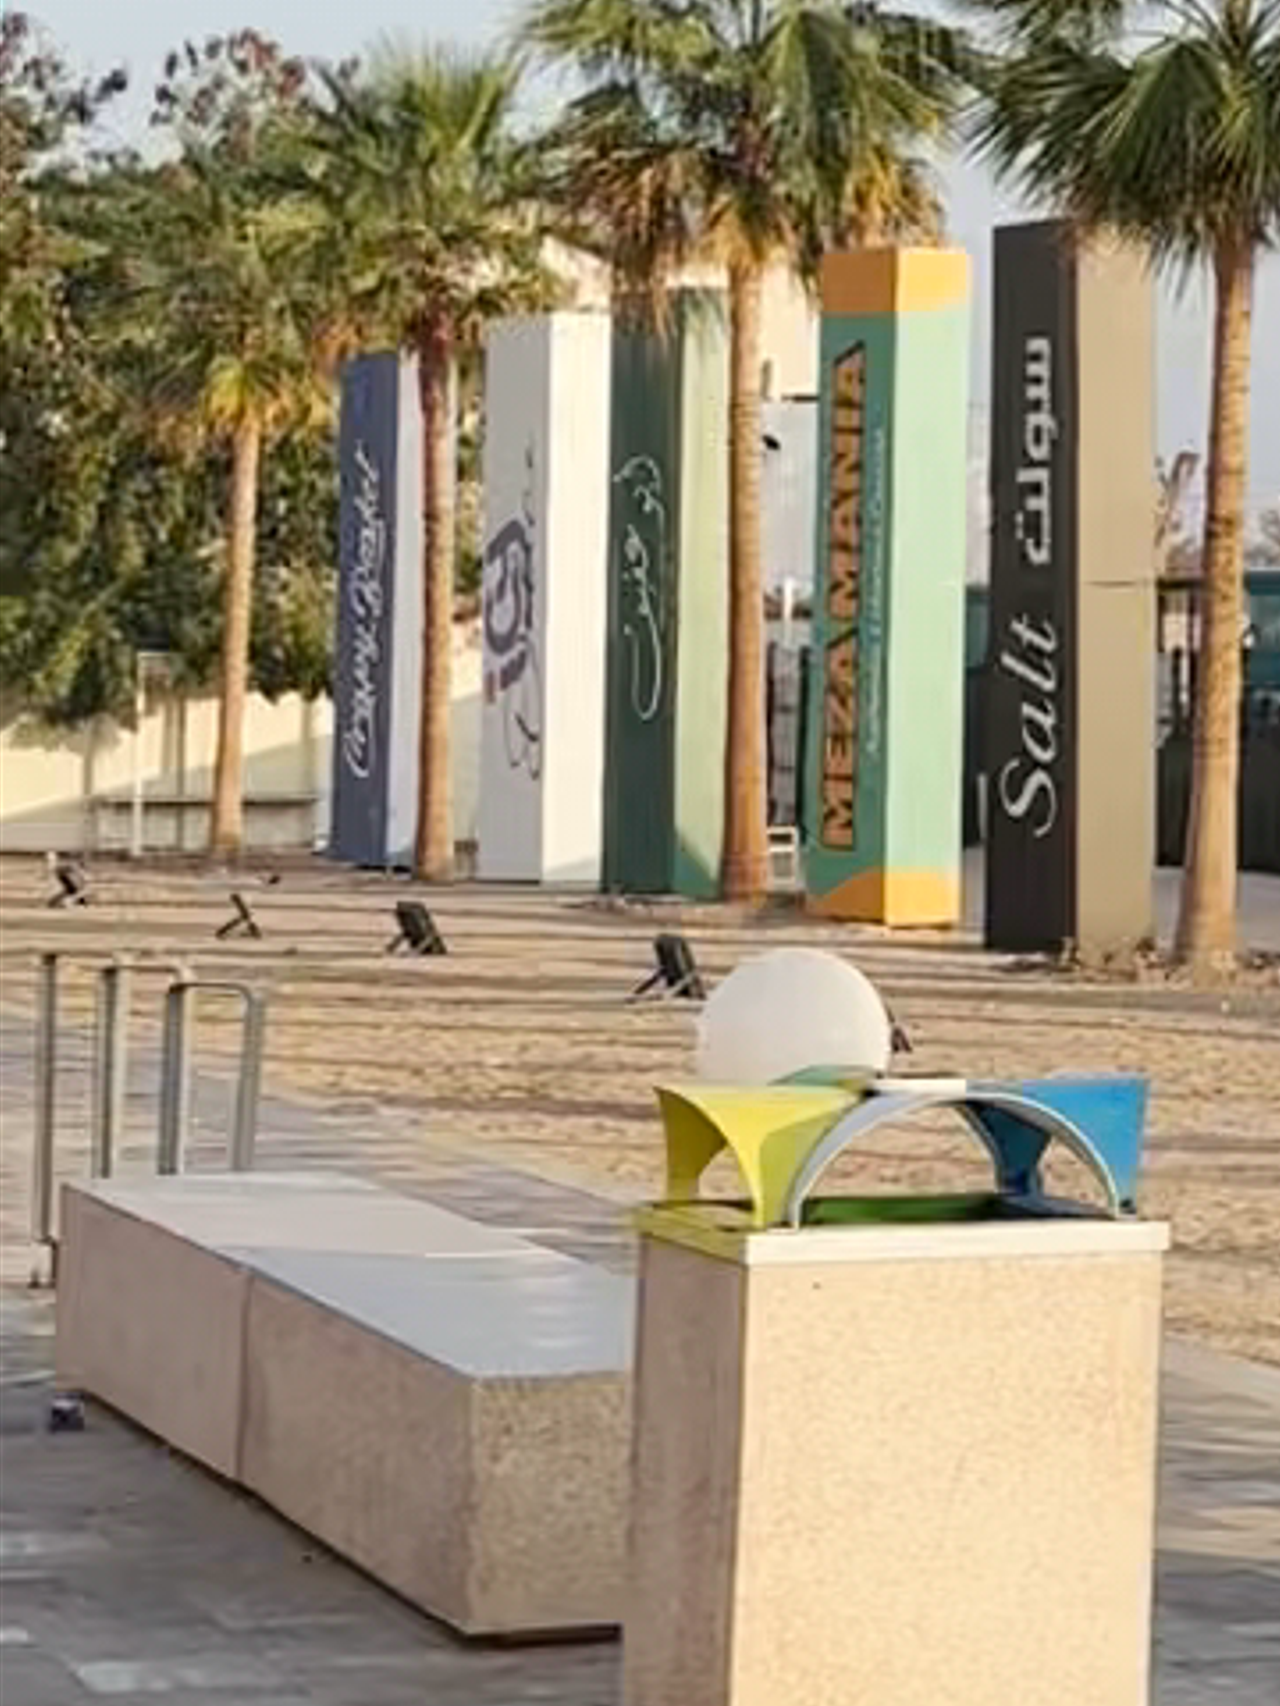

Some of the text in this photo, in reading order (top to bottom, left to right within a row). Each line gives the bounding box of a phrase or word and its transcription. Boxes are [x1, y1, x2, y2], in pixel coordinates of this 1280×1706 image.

[1013, 337, 1058, 564] سولت
[822, 340, 866, 850] MEZA MANIA
[999, 613, 1058, 838] Salt
